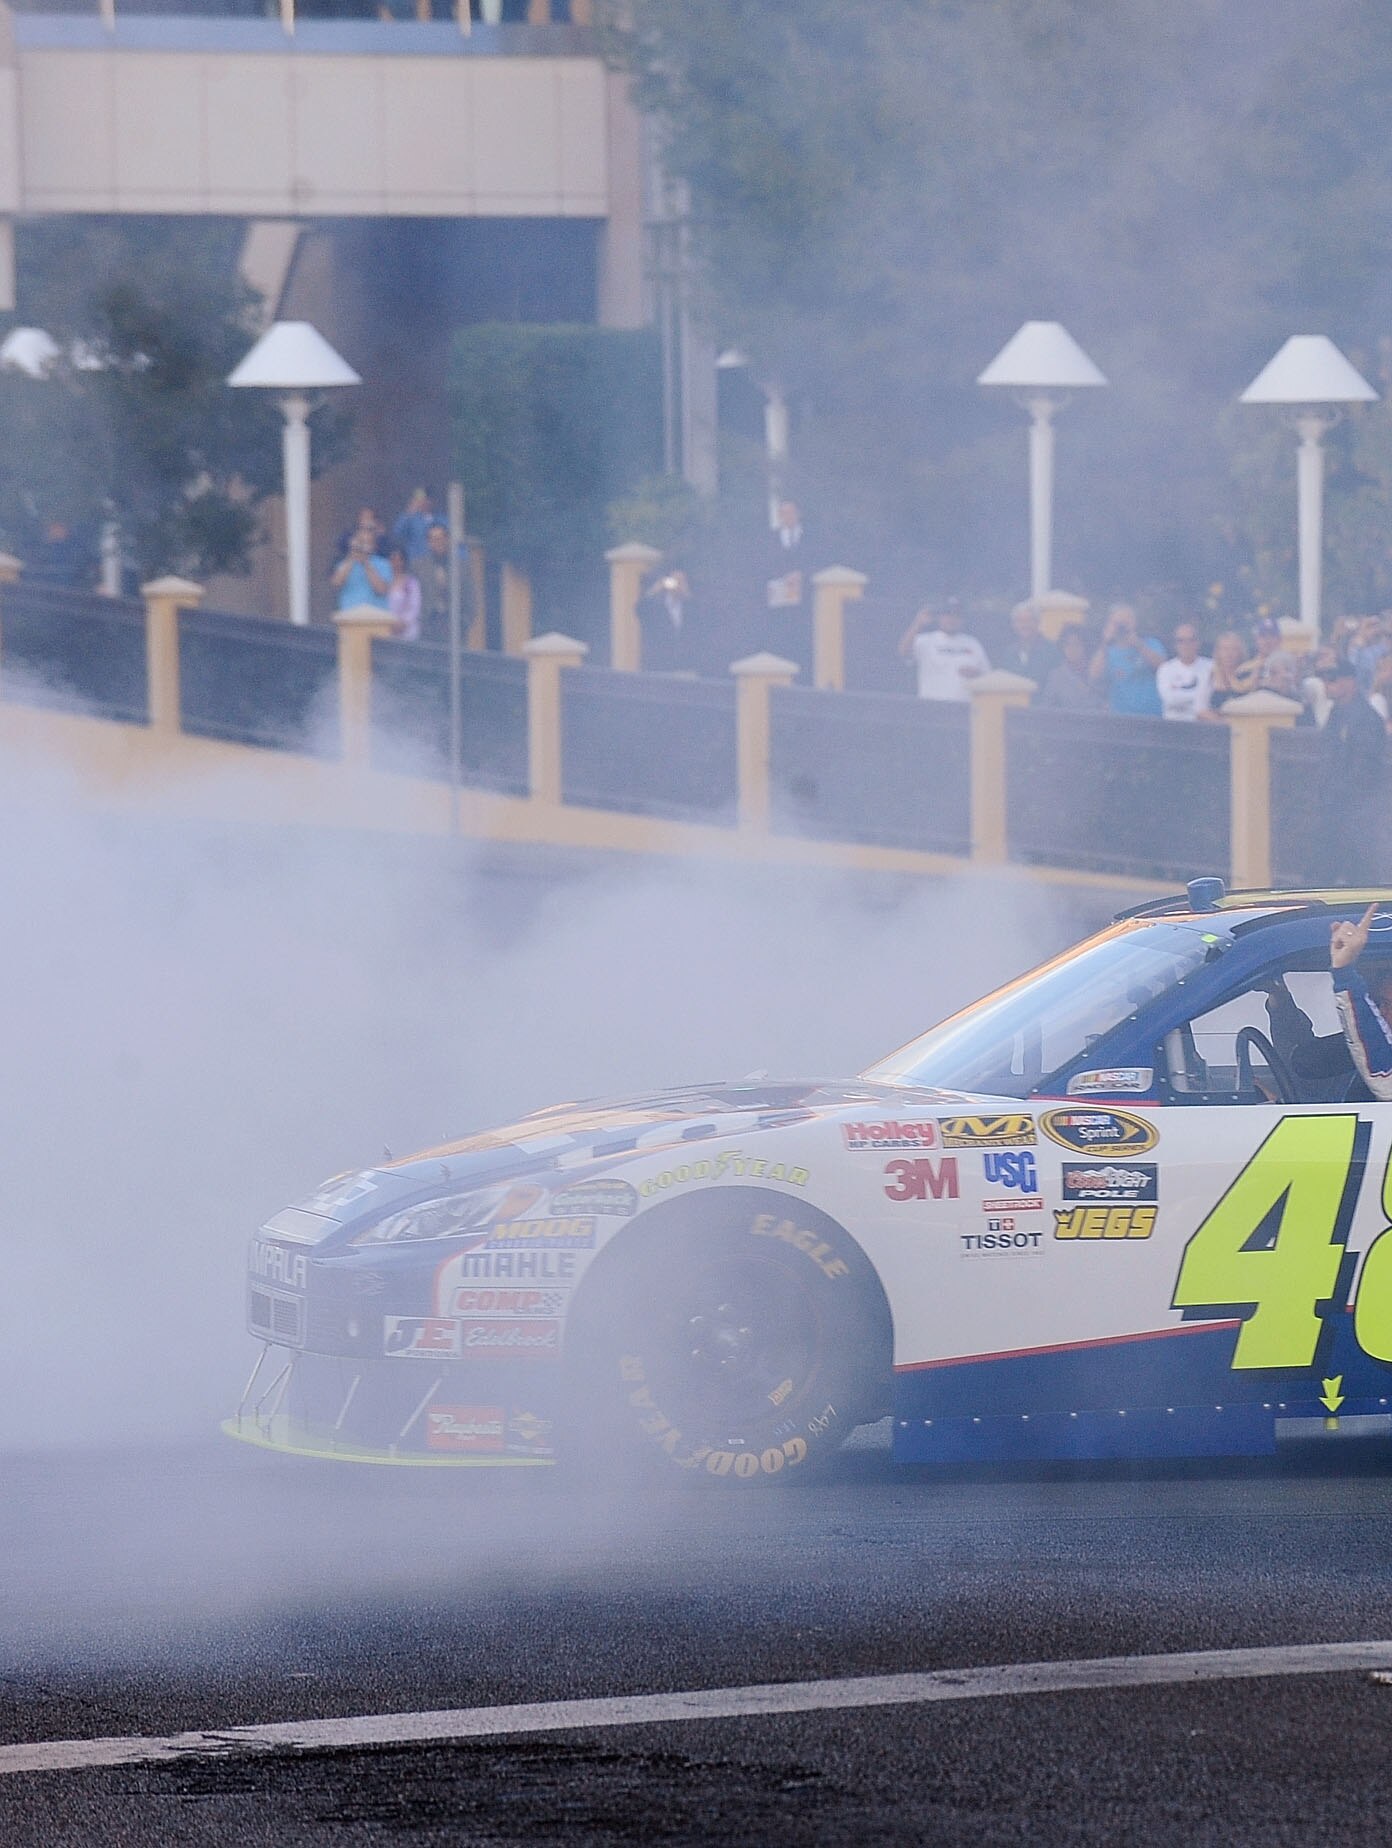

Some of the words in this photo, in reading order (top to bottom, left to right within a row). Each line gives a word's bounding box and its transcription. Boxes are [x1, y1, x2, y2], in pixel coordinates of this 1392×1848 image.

[848, 1121, 934, 1147] Holley
[1078, 1126, 1121, 1141] Sprint
[884, 1157, 960, 1201] 3M
[983, 1151, 1038, 1193] USG
[1078, 1190, 1139, 1199] POLE
[493, 1218, 594, 1240] MOOG
[1055, 1205, 1158, 1240] JEGS
[751, 1214, 849, 1280] EAGLE
[960, 1232, 1043, 1249] TISSOT
[462, 1252, 576, 1278] MAHLE
